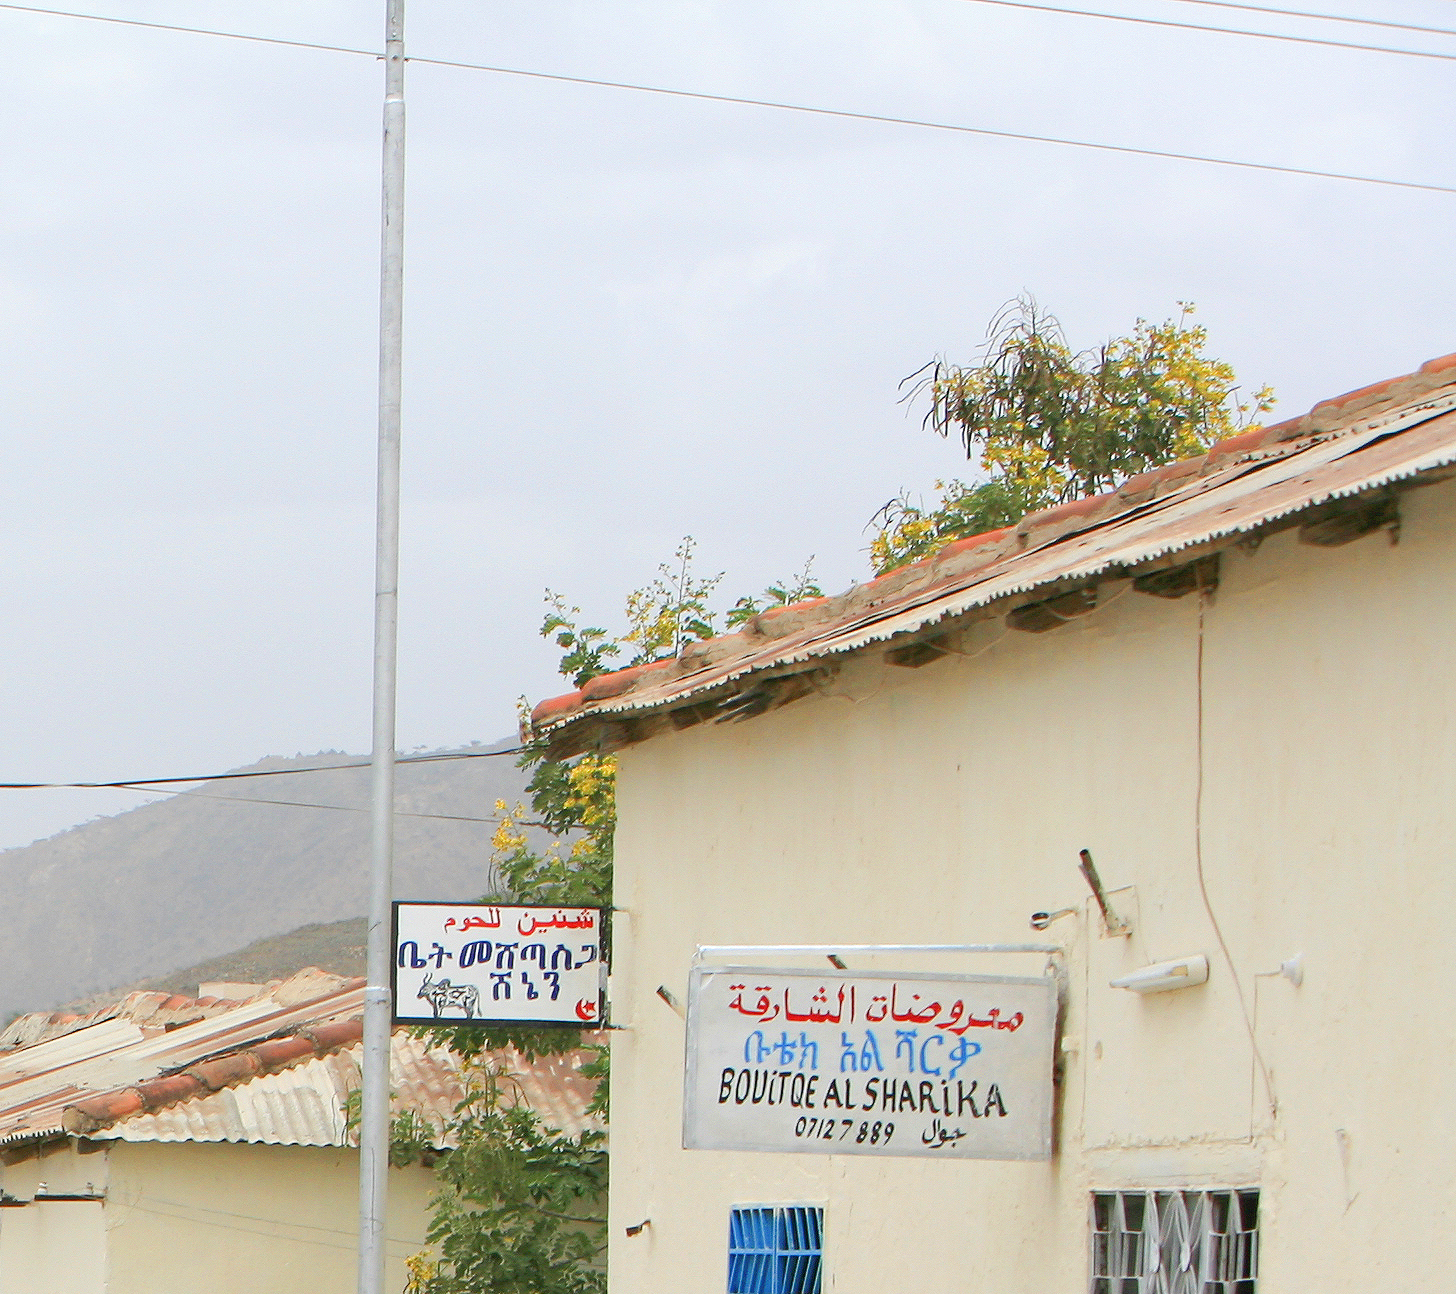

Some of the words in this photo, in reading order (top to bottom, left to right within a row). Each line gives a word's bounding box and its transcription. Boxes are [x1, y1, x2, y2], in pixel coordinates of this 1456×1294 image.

[443, 907, 502, 934] للحوم
[517, 907, 594, 937] شنين
[398, 940, 454, 969] ቤት
[727, 982, 856, 1024] الشارقة
[864, 982, 1025, 1036] معروضات
[823, 1078, 857, 1110] AL
[921, 1118, 967, 1149] جوال
